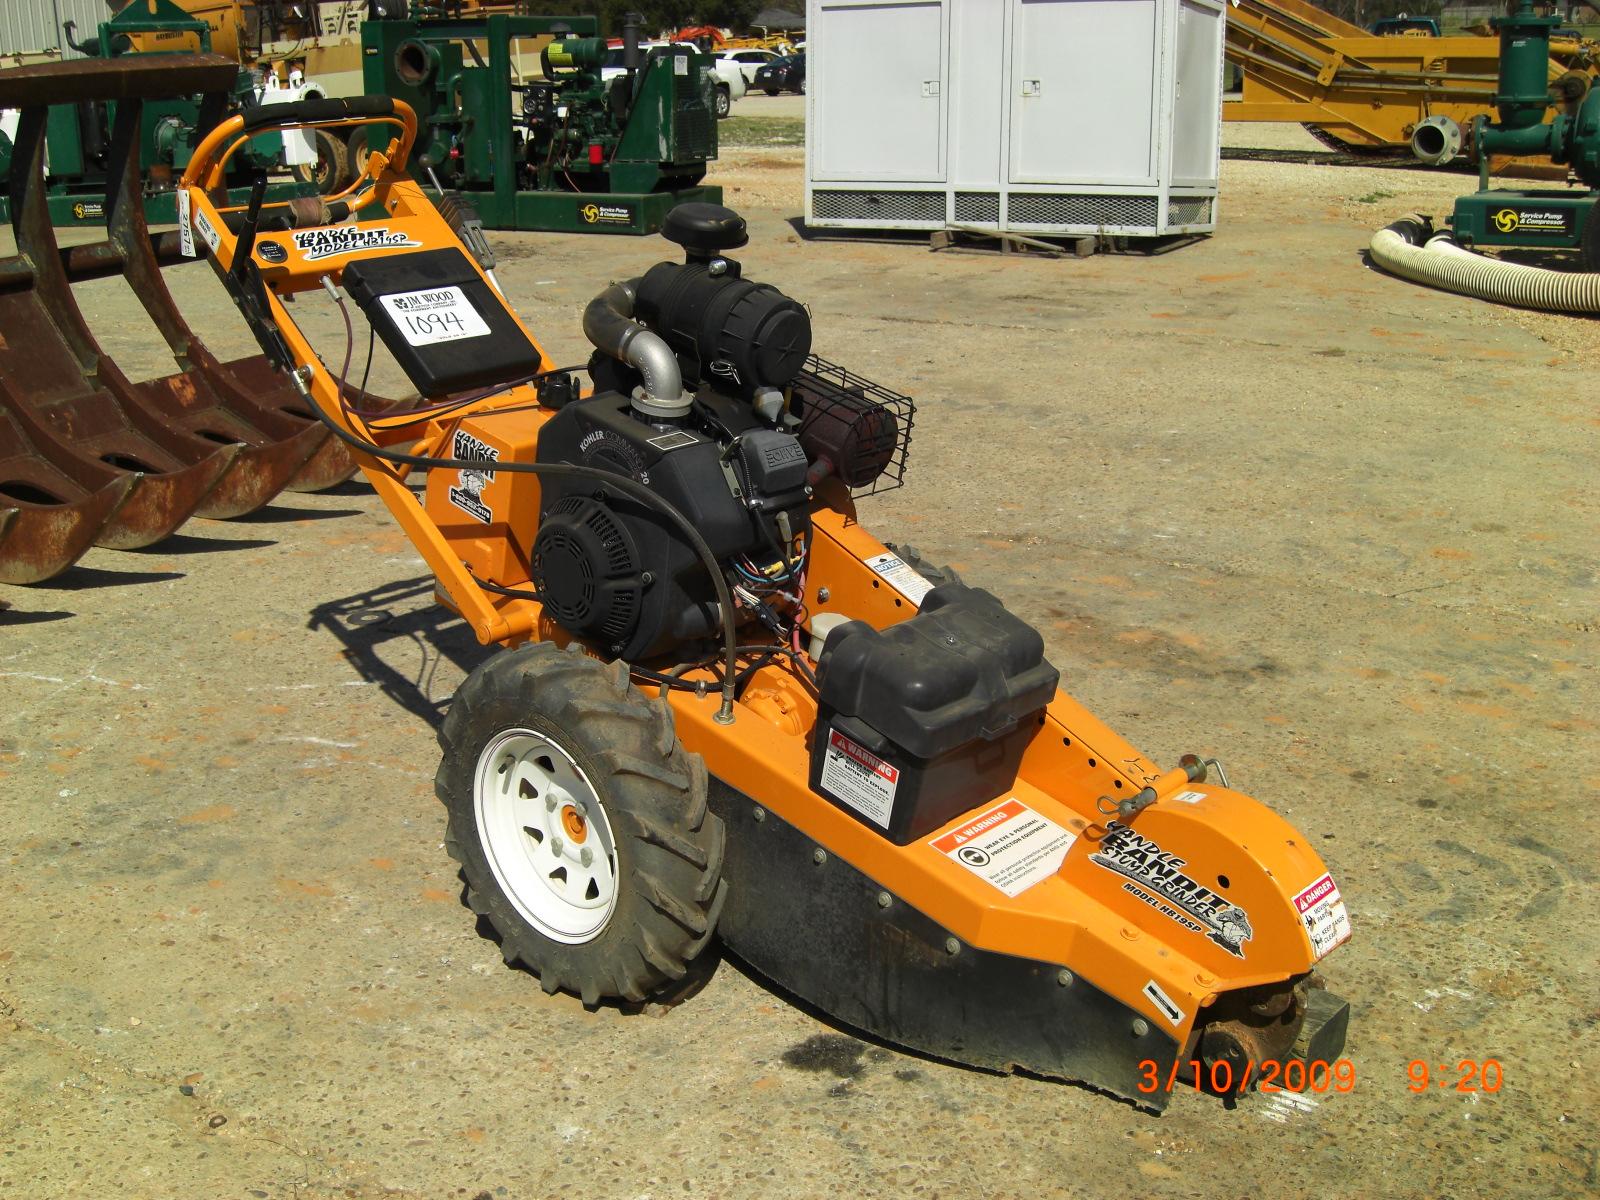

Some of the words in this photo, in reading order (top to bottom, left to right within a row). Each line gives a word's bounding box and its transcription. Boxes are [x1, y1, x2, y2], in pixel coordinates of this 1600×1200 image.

[295, 227, 356, 240] HANDLE
[299, 229, 387, 248] BANDIT
[311, 241, 358, 256] MODEL
[406, 296, 421, 309] JM
[421, 291, 454, 302] WOOD
[405, 311, 464, 334] 1094
[456, 431, 498, 457] HANDLE
[579, 430, 604, 452] KOHLER
[640, 471, 650, 485] 20
[875, 559, 901, 572] NOTICE
[848, 742, 892, 777] WARNING
[963, 811, 1008, 837] WARNING
[984, 840, 1000, 850] WEAR
[999, 834, 1010, 842] EYE
[1013, 819, 1039, 834] PERSONAL
[991, 837, 1022, 857] PROTECTION
[1021, 822, 1048, 840] EQUIPMENT
[1106, 820, 1186, 868] HANDLE
[1102, 833, 1231, 911] BANDIT
[1102, 846, 1150, 876] STUMP
[1151, 876, 1217, 918] GRINDER
[1305, 880, 1332, 902] DANGER
[1123, 883, 1159, 908] MODEL
[1159, 905, 1202, 932] HB19SP
